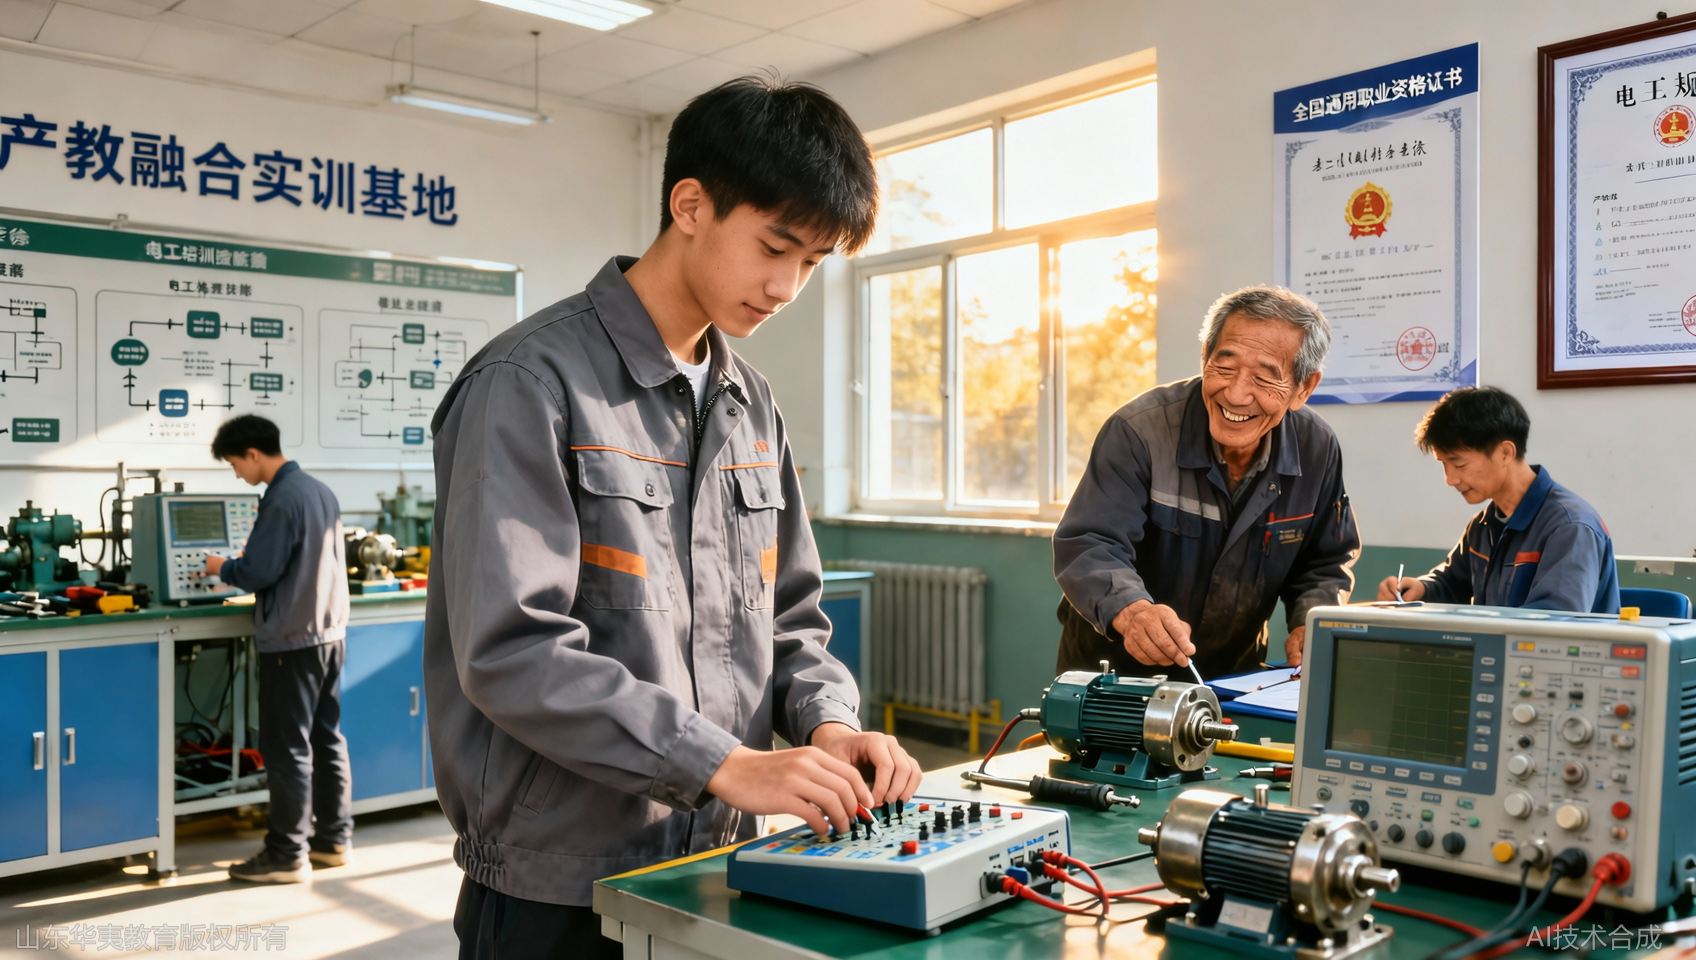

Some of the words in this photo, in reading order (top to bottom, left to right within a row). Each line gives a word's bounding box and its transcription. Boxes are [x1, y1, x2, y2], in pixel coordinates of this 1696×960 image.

[0, 113, 458, 227] 产教融合实训基地
